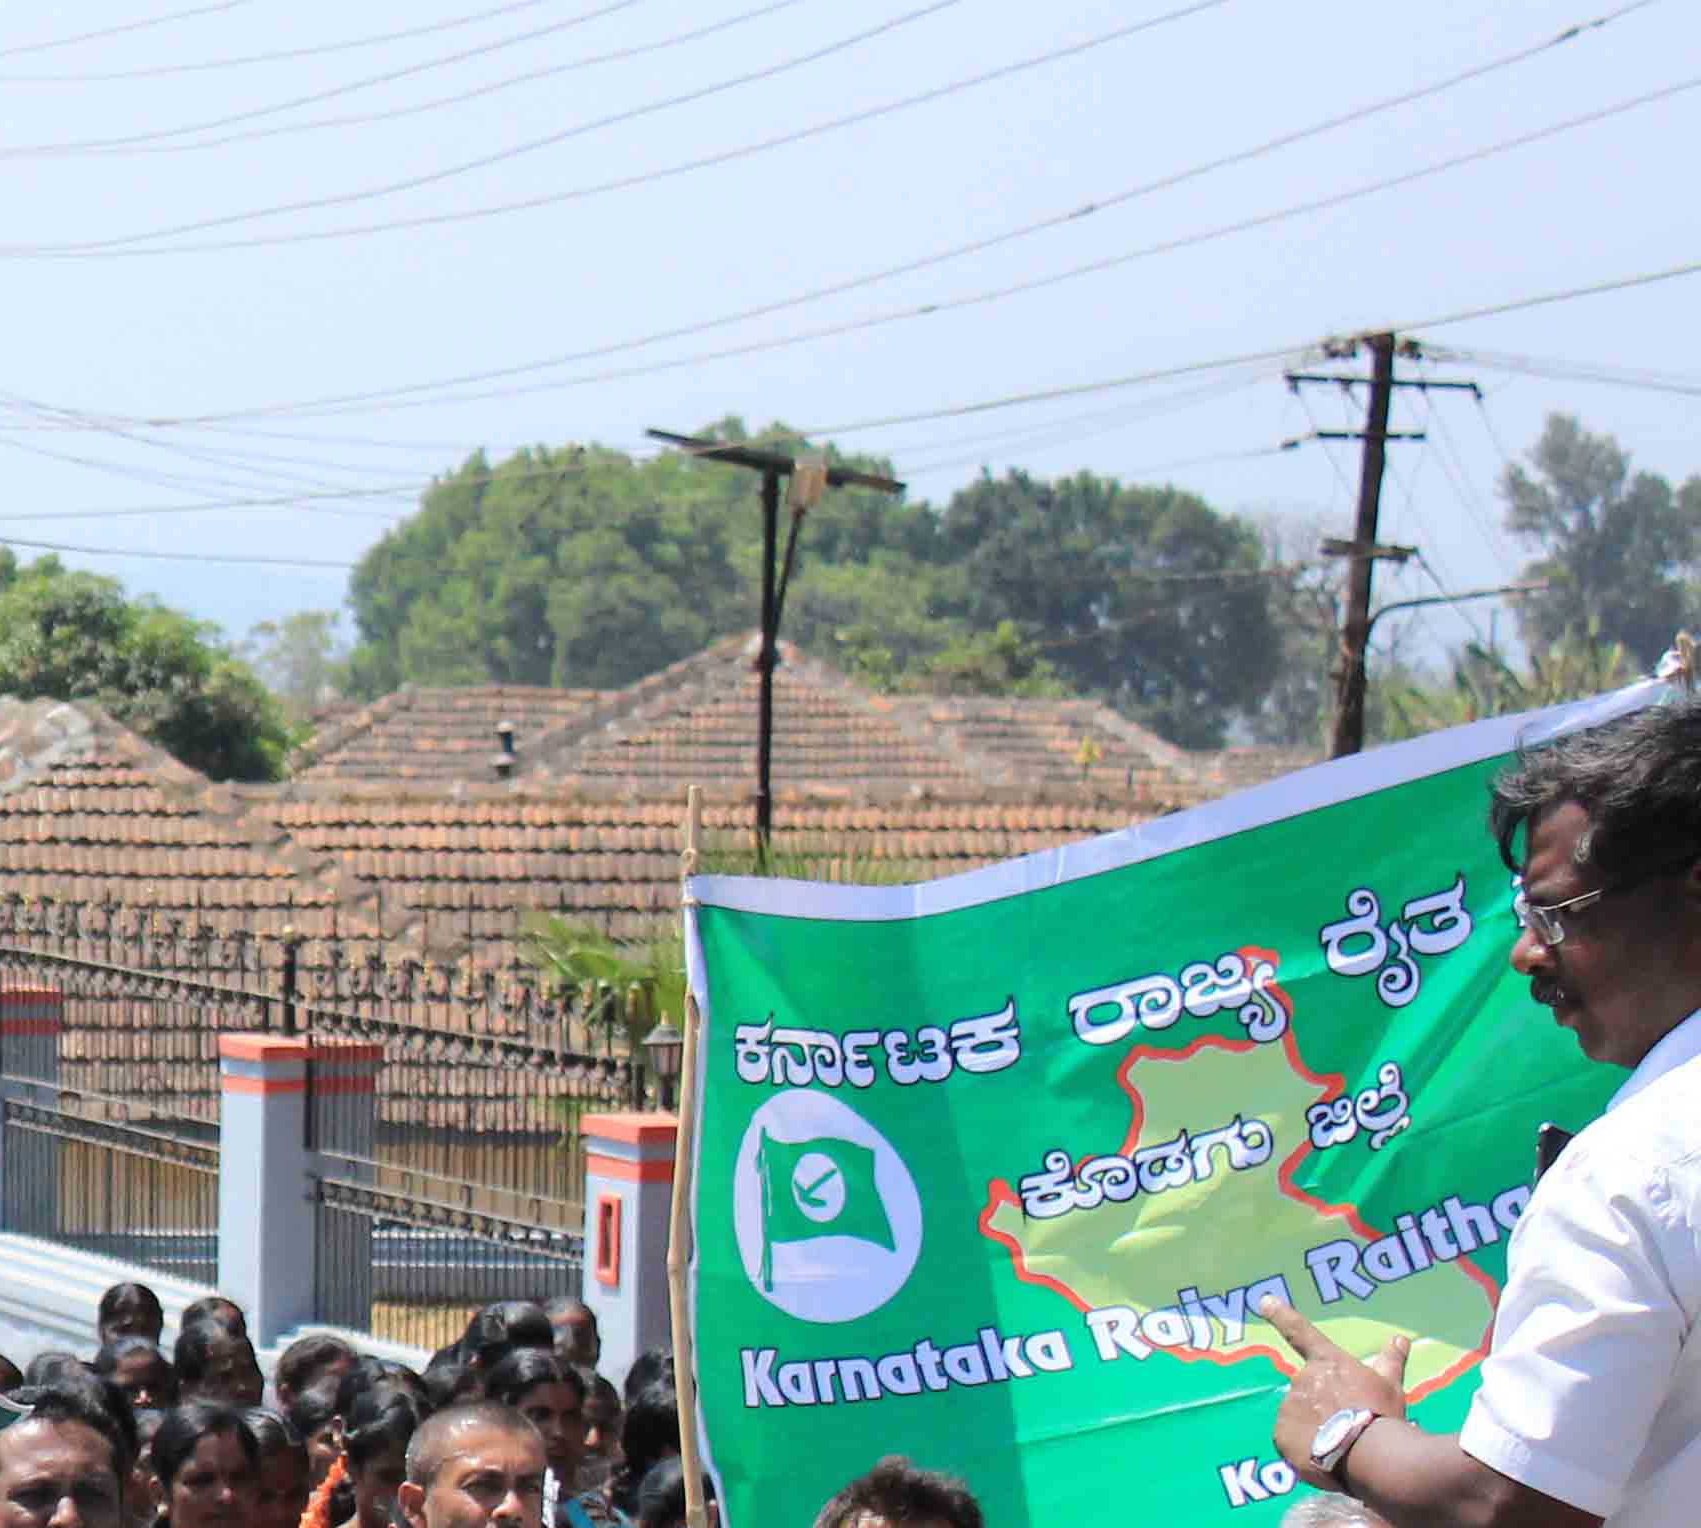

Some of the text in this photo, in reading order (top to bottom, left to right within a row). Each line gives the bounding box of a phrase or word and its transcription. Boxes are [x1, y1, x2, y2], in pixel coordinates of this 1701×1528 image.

[733, 998, 1022, 1088] ಕರ್ನಾಟಕ
[1068, 947, 1293, 1042] ರಾಜ್ಯ
[1320, 872, 1474, 1008] ರೈತ
[1021, 1061, 1413, 1220] ಕೊಡಗು ಜಿಲ್ಲೆ
[741, 1324, 1072, 1409] Karnataka
[1085, 1274, 1294, 1362] Rajya
